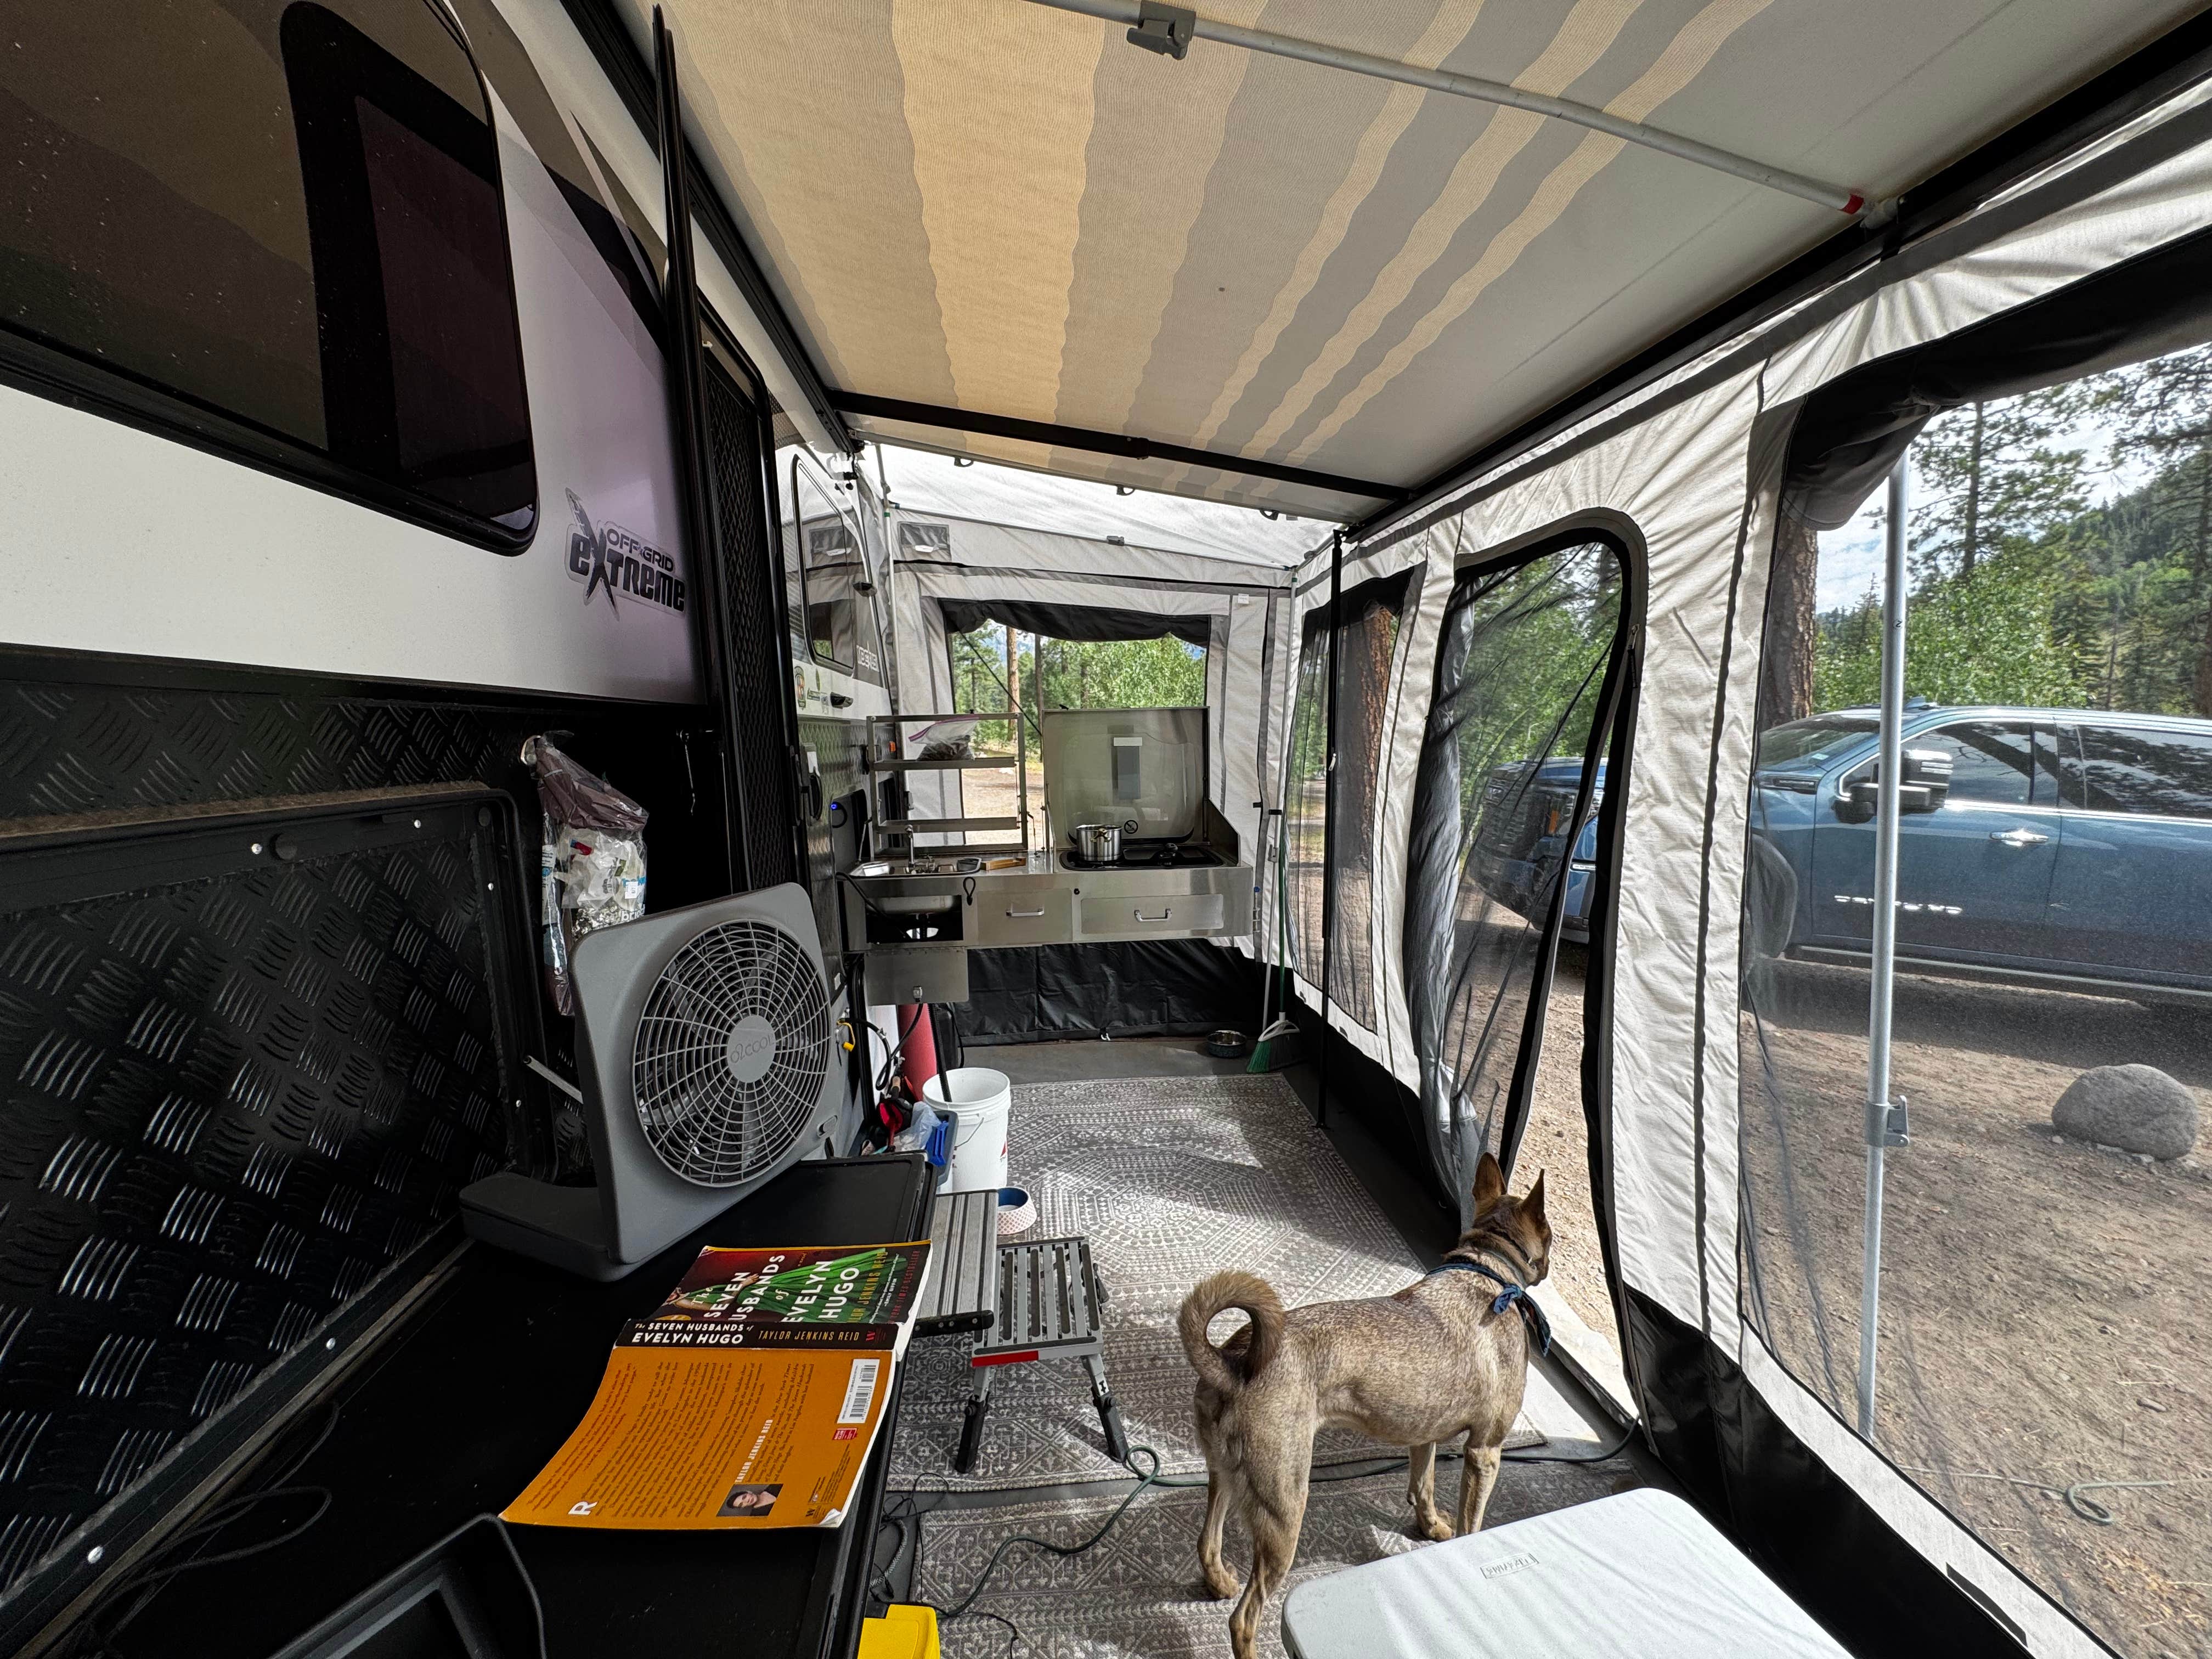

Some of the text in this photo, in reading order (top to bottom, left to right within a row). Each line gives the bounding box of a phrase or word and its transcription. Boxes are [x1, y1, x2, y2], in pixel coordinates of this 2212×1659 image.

[691, 1286, 714, 1305] The
[704, 1272, 751, 1318] SEVEN
[728, 1255, 785, 1321] USBANDS
[775, 1289, 789, 1300] of
[780, 1261, 834, 1323] EVELYN
[818, 1267, 860, 1319] HUGO
[857, 1272, 881, 1305] JENKINS
[631, 1332, 743, 1344] EVELYN HUGO
[686, 1323, 744, 1331] HUSBANDS
[758, 1330, 791, 1340] TAYLOR
[794, 1331, 834, 1341] JENKINS
[838, 1331, 860, 1341] REID
[734, 1462, 752, 1482] TAYLOR
[747, 1435, 766, 1459] JENKINS
[760, 1419, 773, 1432] REID
[568, 1501, 598, 1515] R
